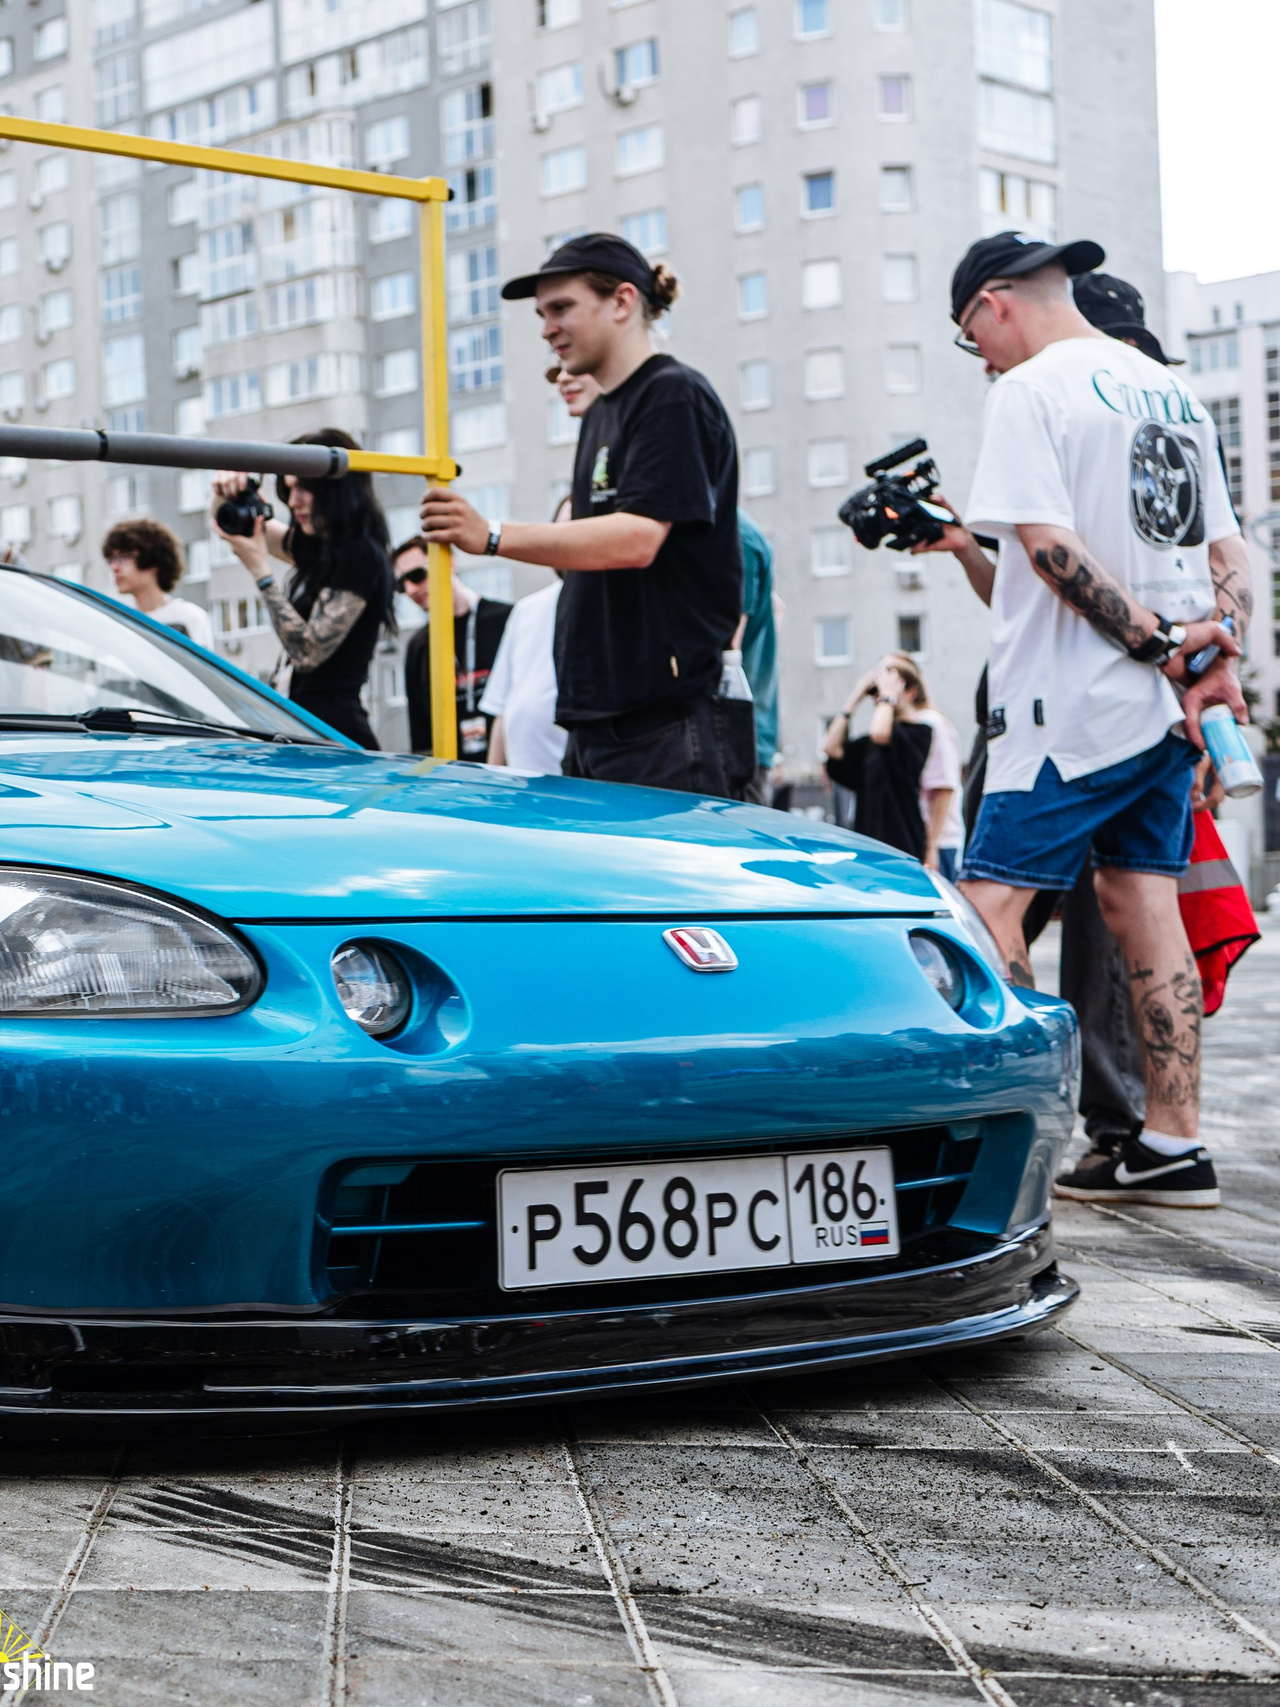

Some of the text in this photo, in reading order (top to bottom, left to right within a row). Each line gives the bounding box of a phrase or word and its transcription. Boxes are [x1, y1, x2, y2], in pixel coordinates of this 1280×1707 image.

[527, 1160, 876, 1270] P568PC 186
[815, 1225, 858, 1248] RUS
